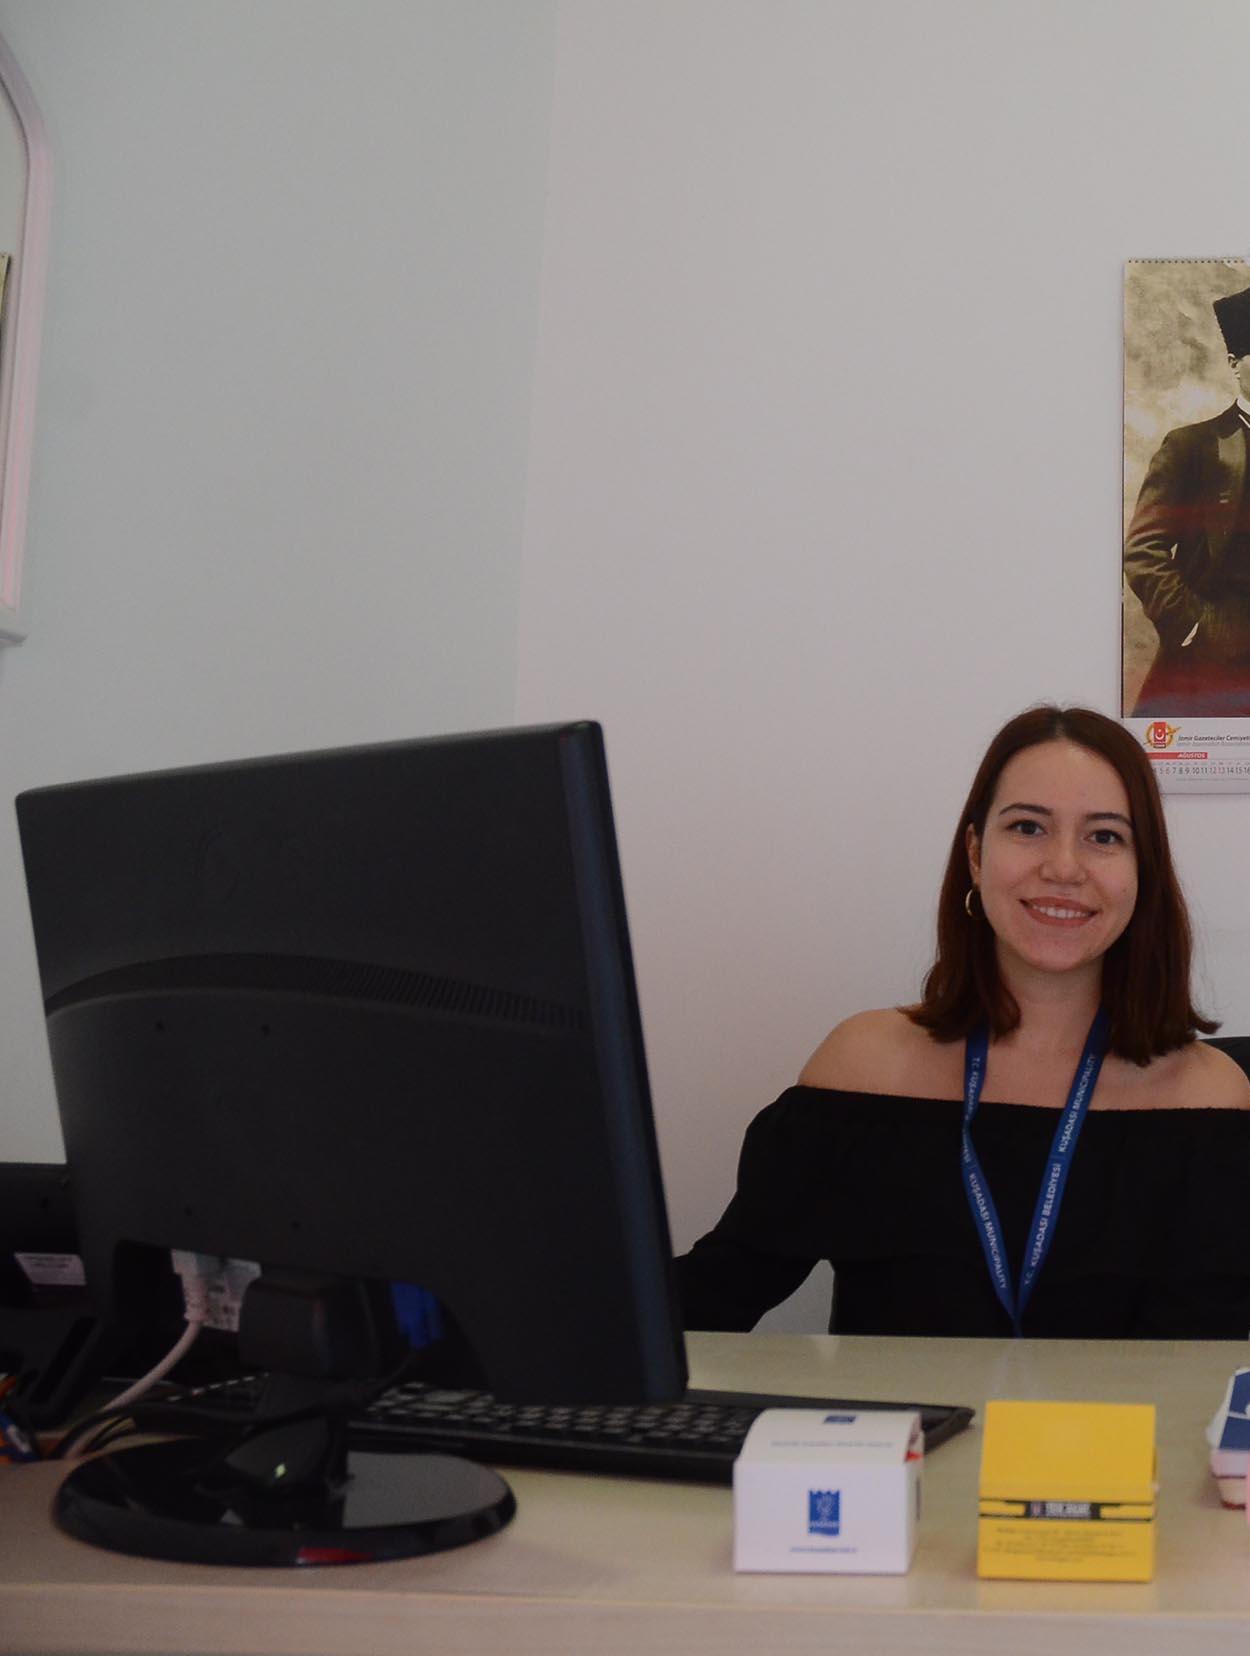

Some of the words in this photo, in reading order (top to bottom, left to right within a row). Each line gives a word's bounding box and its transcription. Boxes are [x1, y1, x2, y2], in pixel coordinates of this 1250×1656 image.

[1057, 1111, 1079, 1152] KUŞADASI
[1072, 1054, 1097, 1110] MUNICIPALITY
[968, 1173, 990, 1222] KUŞADASI
[984, 1221, 1009, 1289] MUNICIPALITY
[1030, 1217, 1049, 1267] KUŞADASI
[1042, 1163, 1062, 1216] BELEDİYESİ
